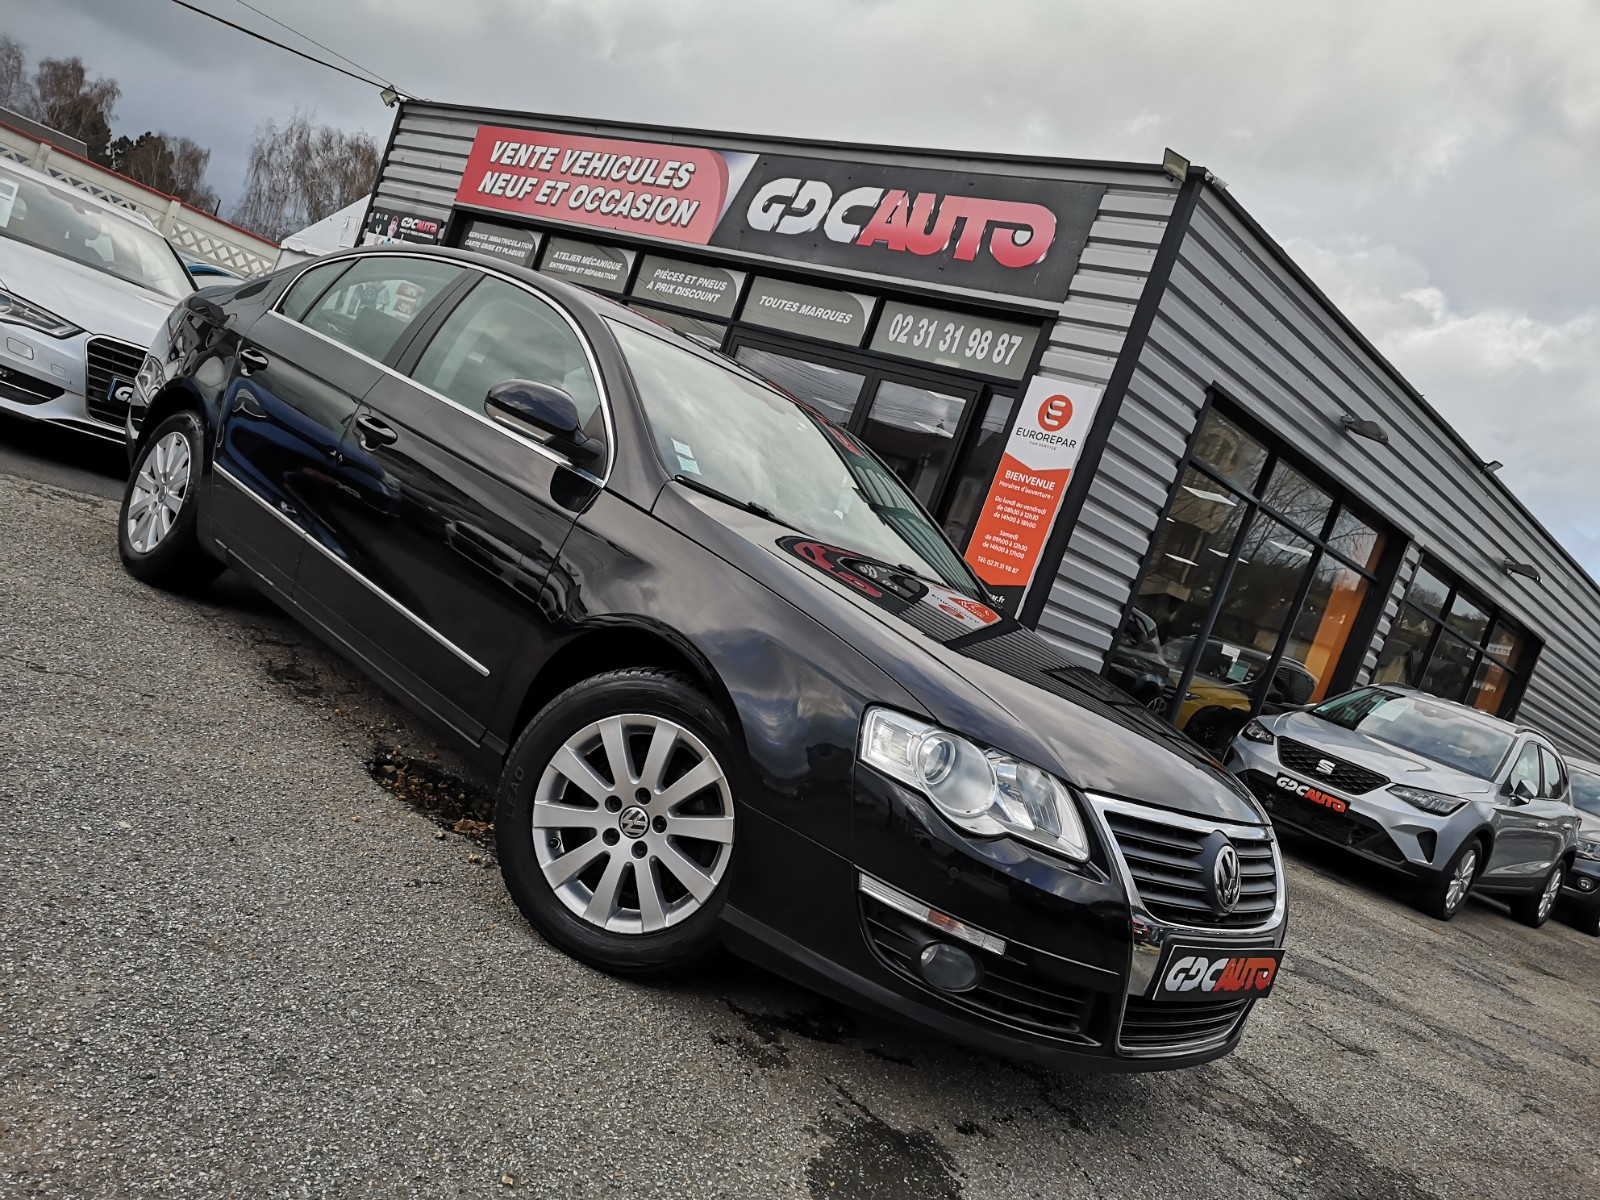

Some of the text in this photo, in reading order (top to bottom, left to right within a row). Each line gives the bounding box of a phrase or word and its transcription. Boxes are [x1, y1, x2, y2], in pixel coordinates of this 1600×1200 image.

[490, 140, 696, 189] VENTE VEHICULES
[477, 171, 700, 227] NEUF ET OCCASION
[747, 178, 1057, 268] GDCAUTO
[465, 240, 481, 248] CARTE
[480, 243, 496, 252] GRISE
[502, 247, 526, 258] PLAQUES
[468, 231, 534, 250] SERVICE IMMATRICULATION
[553, 251, 623, 270] ATELIER MÉCANIQUE
[549, 262, 577, 272] ENTRETIEN
[584, 268, 618, 280] RÉPARATION
[654, 268, 727, 291] PIÈCES ET PNEUS
[654, 282, 676, 294] PRIX
[674, 287, 720, 303] DISCOUNT
[759, 295, 853, 324] TOUTES MARQUES
[888, 313, 1023, 365] 02 31 31 98 87
[1016, 427, 1076, 449] EUROREPAR
[999, 480, 1020, 490] Horaires
[1020, 486, 1051, 500] d'ouverture
[1005, 470, 1056, 490] BIENVENUE
[1003, 497, 1016, 506] lundi
[1023, 505, 1046, 515] vendredi
[1001, 514, 1017, 523] 14h00
[1024, 512, 1039, 521] 12h30
[999, 530, 1019, 540] Samedi
[990, 543, 1005, 553] 14h00
[1009, 550, 1025, 559] 17h00
[1013, 542, 1028, 552] 12h30
[1276, 776, 1346, 813] GDCAUTO
[1164, 956, 1276, 992] GDCAUTO
